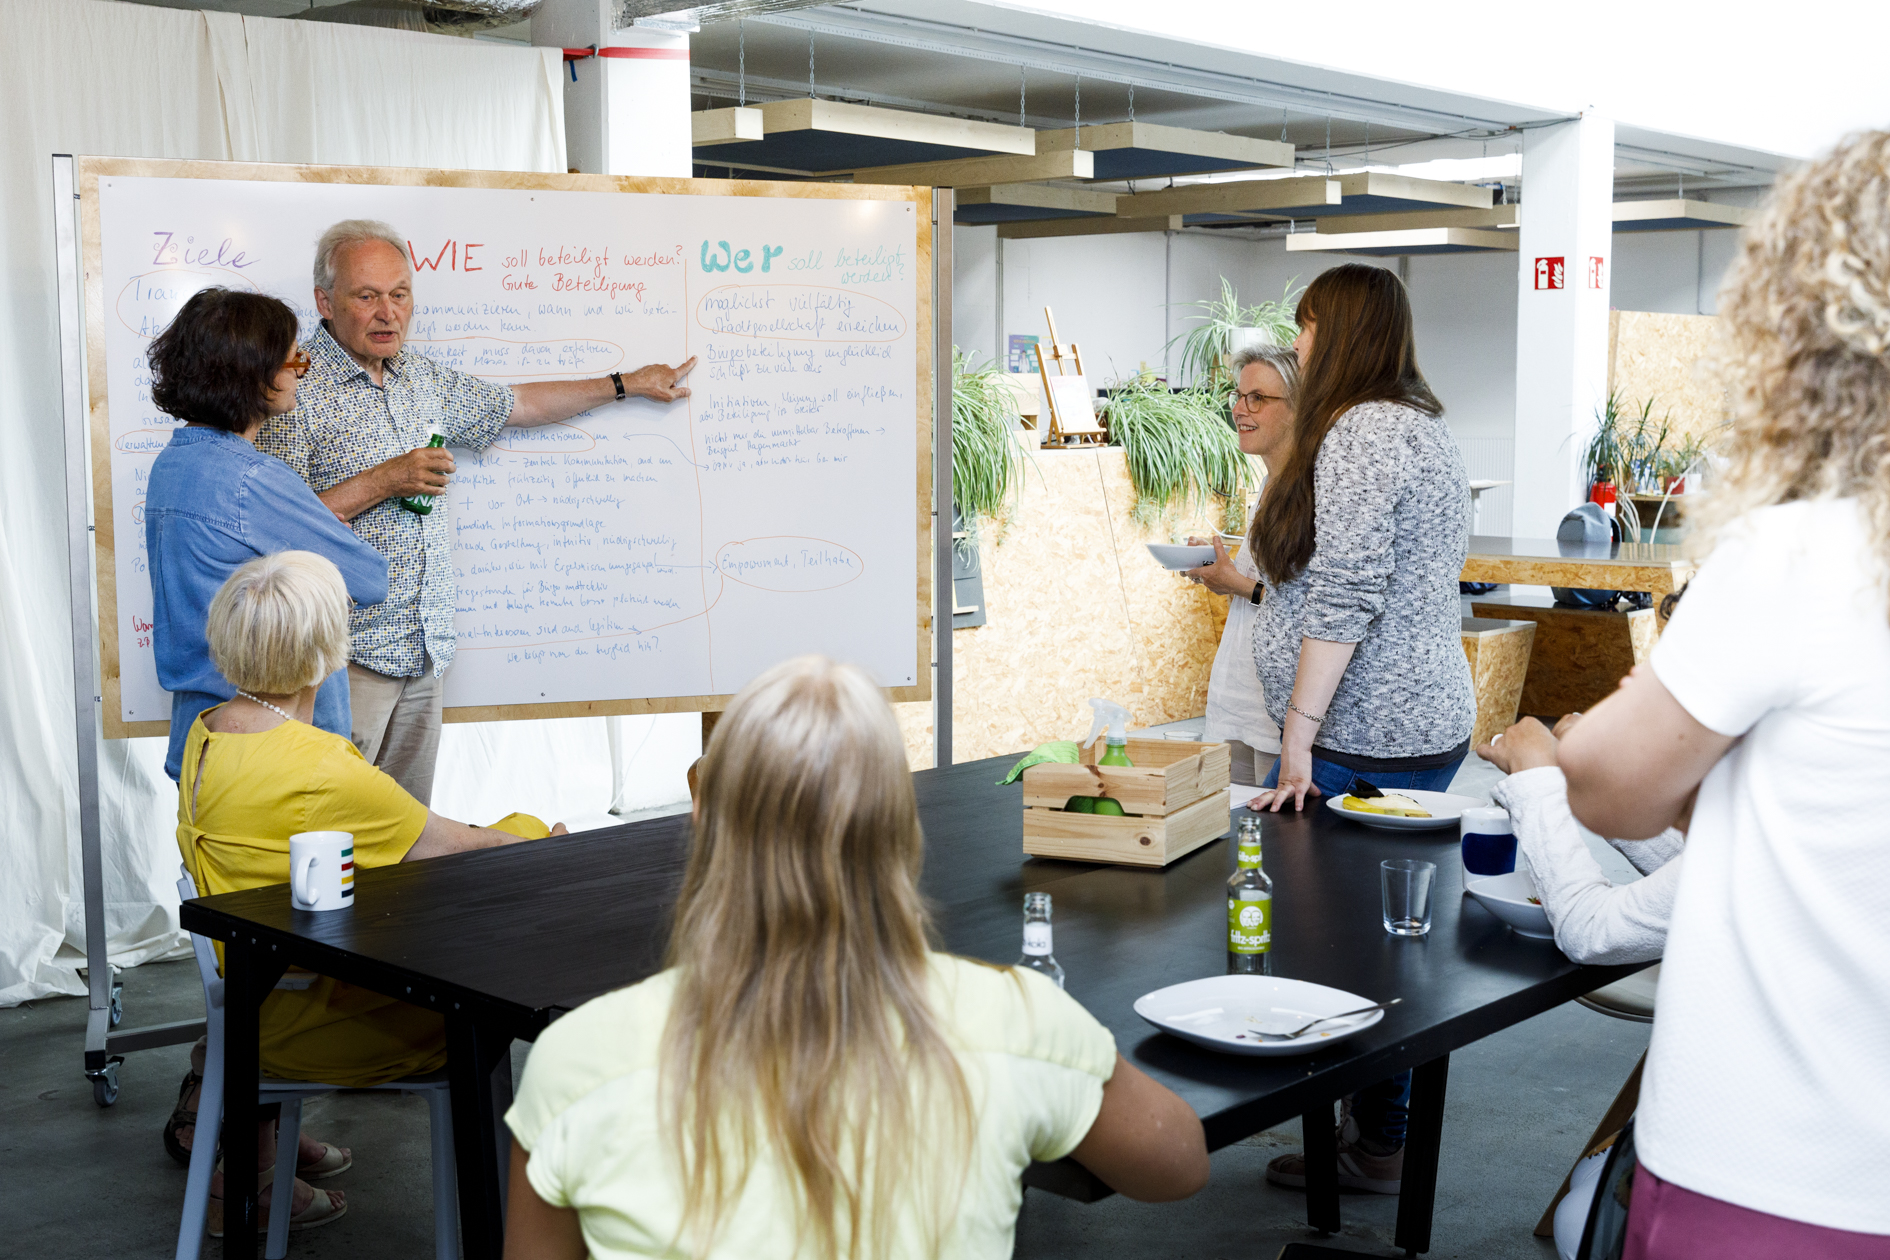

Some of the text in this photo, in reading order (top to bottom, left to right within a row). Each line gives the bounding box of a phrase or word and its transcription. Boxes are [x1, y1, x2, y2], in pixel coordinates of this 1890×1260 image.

[153, 231, 261, 269] Ziele
[408, 239, 683, 277] WIE soll beteiligt werden?
[700, 239, 907, 274] Wer soll beteiligt
[840, 263, 905, 286] werden?
[502, 272, 647, 302] Gute Beteiligung
[538, 303, 572, 317] wann
[583, 303, 605, 316] und
[615, 303, 634, 315] wie
[705, 290, 856, 321] möglichst vielfältig
[445, 321, 490, 333] werden
[712, 315, 900, 338] Stadtgesellschaft erreichen
[482, 347, 510, 357] muss
[521, 342, 552, 355] davon
[562, 341, 613, 356] erfahren
[706, 341, 892, 367] Bürgerbeteiligung unglücklich
[756, 363, 773, 374] zu
[821, 387, 839, 404] soll
[800, 549, 855, 569] Teilhabe
